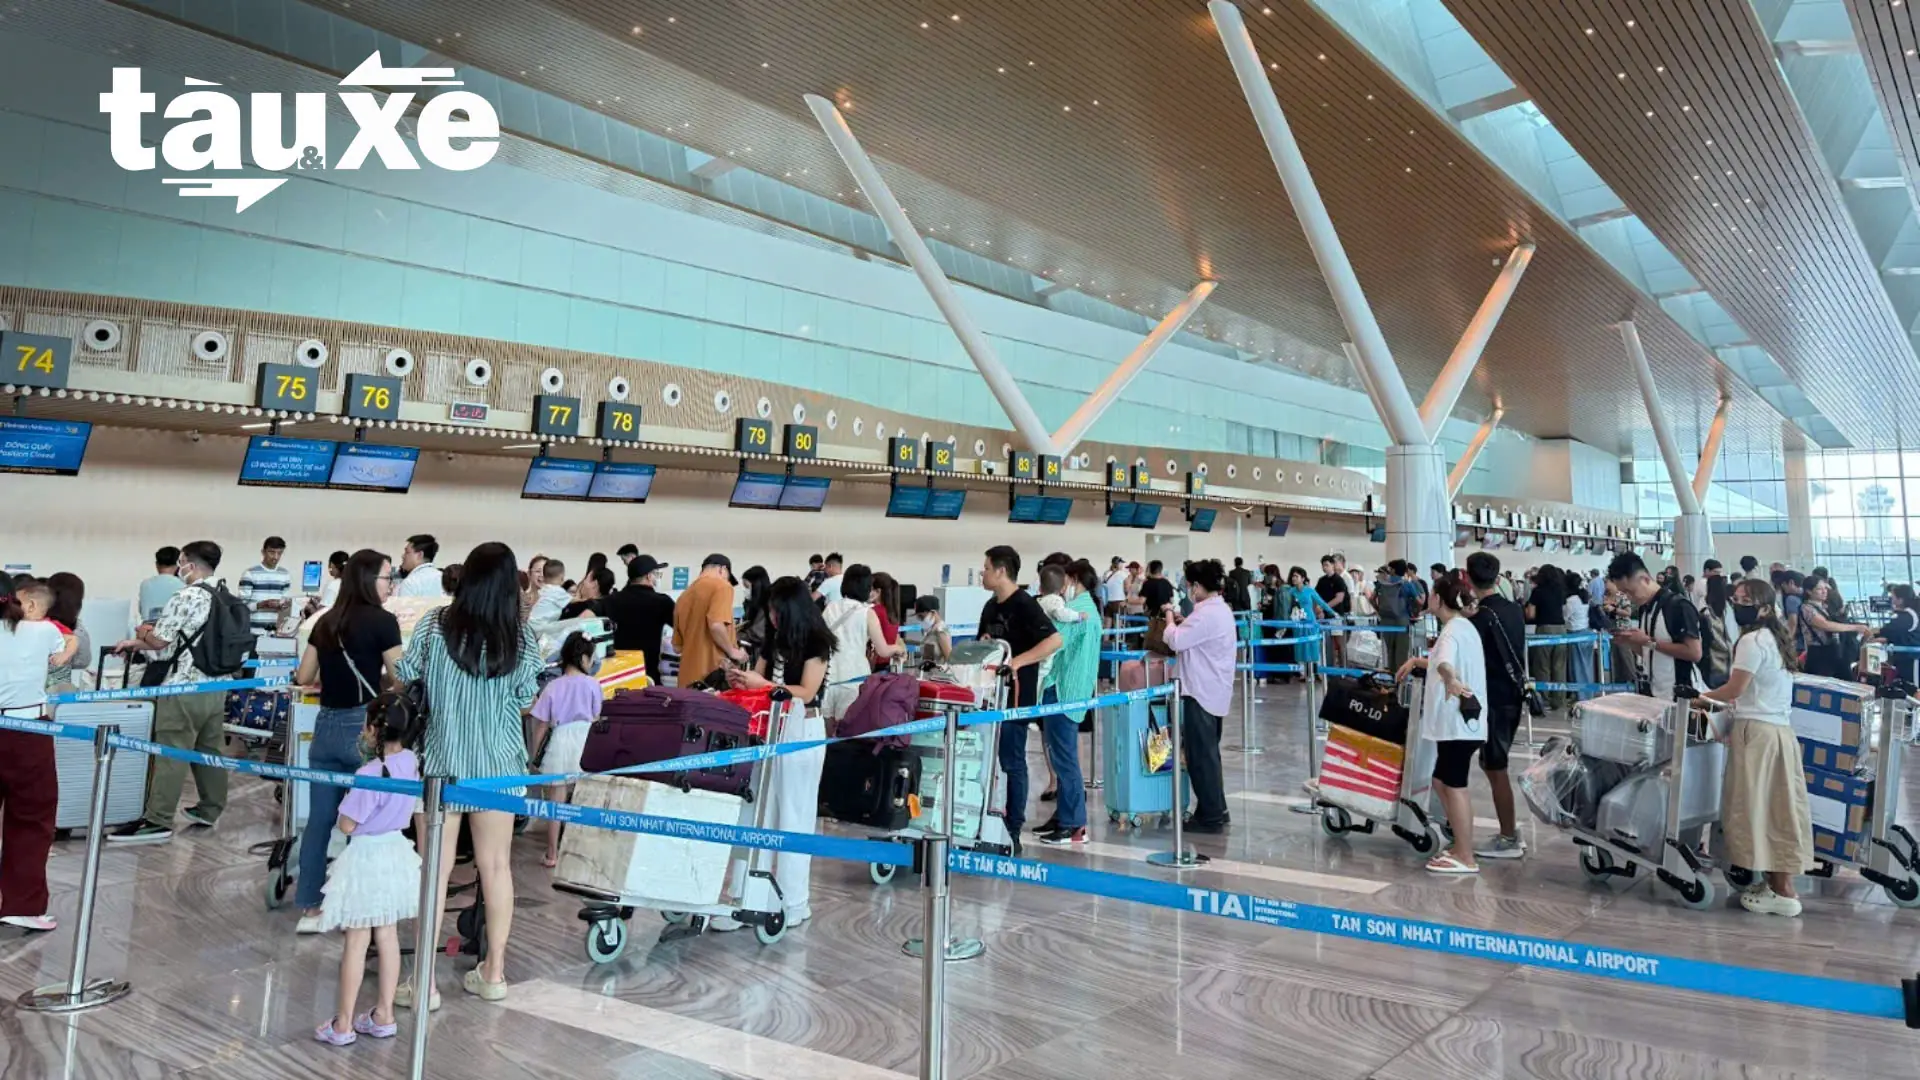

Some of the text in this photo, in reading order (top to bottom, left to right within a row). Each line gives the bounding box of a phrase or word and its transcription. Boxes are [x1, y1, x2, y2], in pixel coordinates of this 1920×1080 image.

[16, 345, 54, 375] 74
[276, 375, 306, 400] 75
[362, 385, 390, 410] 76
[548, 405, 572, 426] 77
[612, 411, 633, 432] 78
[748, 426, 766, 445] 79
[795, 432, 812, 450] 80
[900, 444, 913, 461] 81
[936, 449, 950, 465] 82
[1018, 457, 1030, 472] 83
[1047, 461, 1059, 475] 84
[260, 659, 278, 667] TIA
[264, 676, 286, 686] TIA
[202, 753, 223, 767] TIA
[524, 799, 549, 817] TIA
[600, 812, 785, 849] TAN SON NHAT INTERNATIONAL AIRPORT
[958, 851, 971, 870] TẾ
[973, 855, 994, 873] TÂN
[996, 859, 1017, 877] SƠN
[1020, 862, 1048, 882] NHẤT
[1187, 888, 1246, 918] TIA
[1254, 906, 1299, 919] INTERNATIONAL
[1332, 914, 1660, 976] TAN SON NHAT INTERNATIONAL AIRPORT
